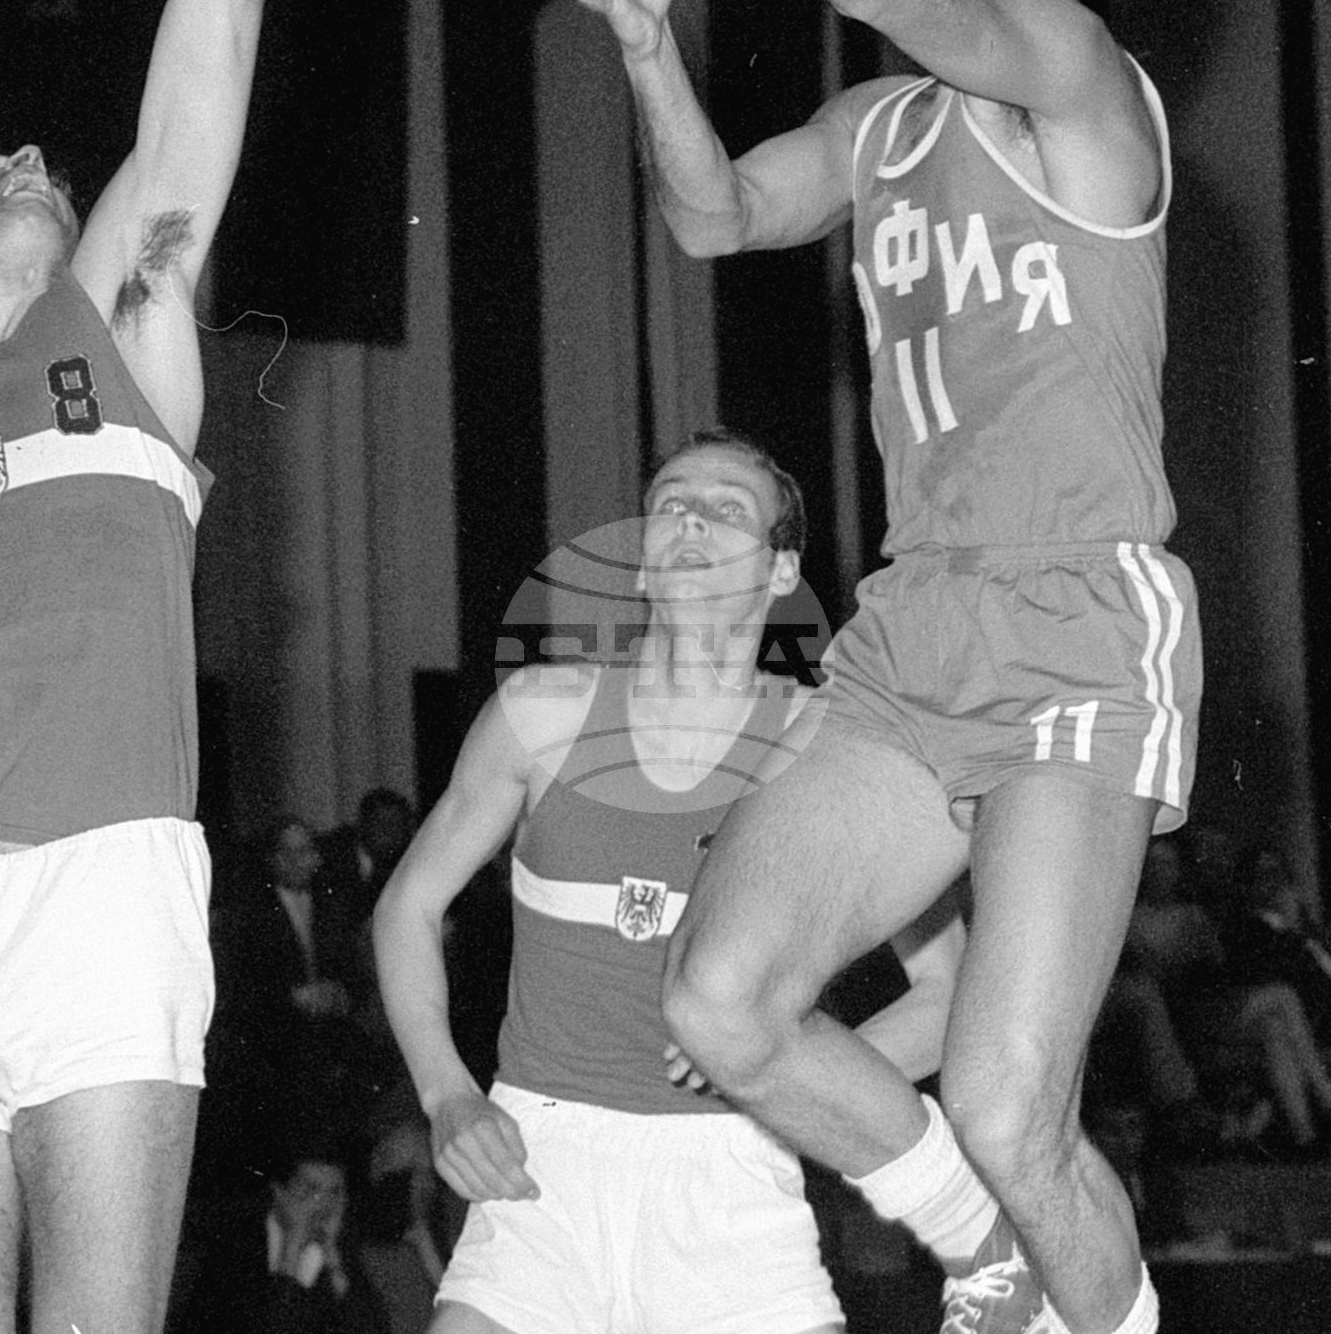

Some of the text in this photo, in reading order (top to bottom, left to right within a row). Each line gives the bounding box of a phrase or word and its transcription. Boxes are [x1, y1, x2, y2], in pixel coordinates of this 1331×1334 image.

[44, 354, 104, 435] 8
[895, 326, 958, 445] 11
[1030, 700, 1099, 763] 11
